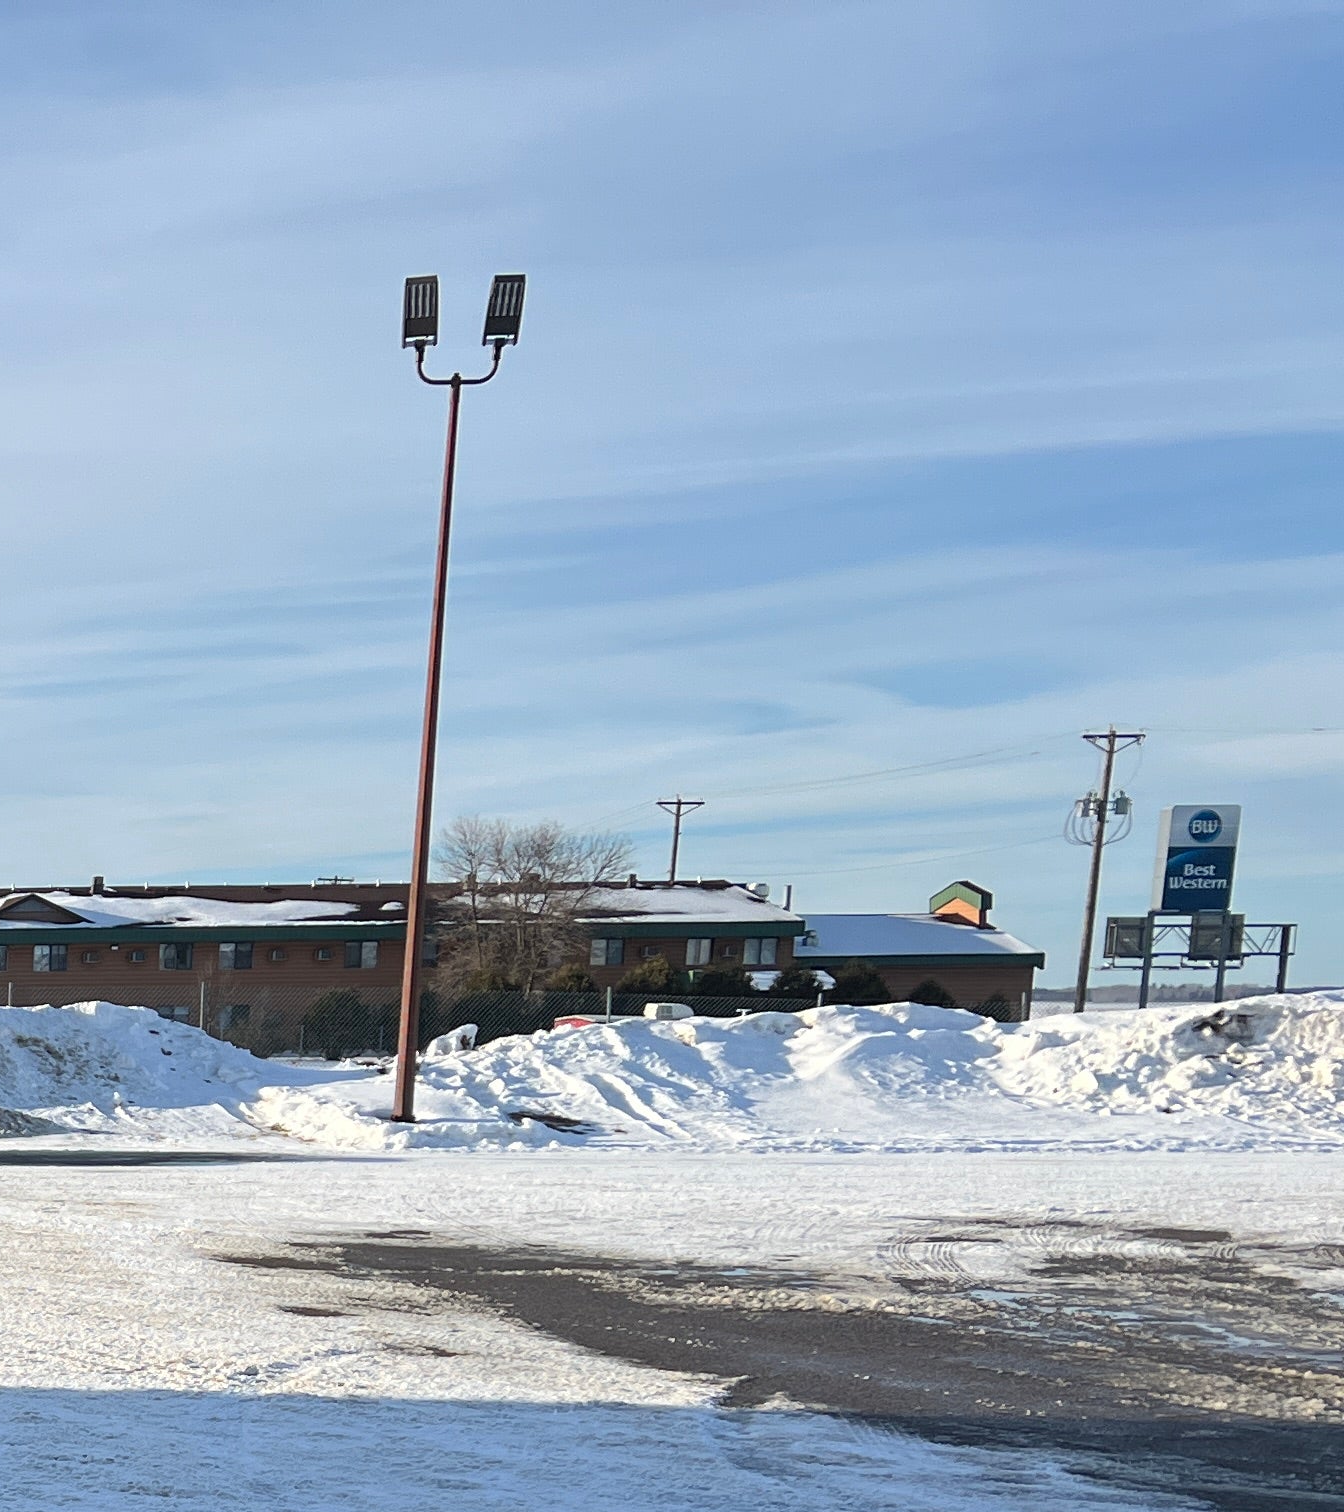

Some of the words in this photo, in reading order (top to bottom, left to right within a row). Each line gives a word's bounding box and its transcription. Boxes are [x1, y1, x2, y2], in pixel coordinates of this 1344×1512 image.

[1192, 819, 1218, 834] BW
[1183, 863, 1216, 876] Best
[1169, 876, 1227, 889] Western
